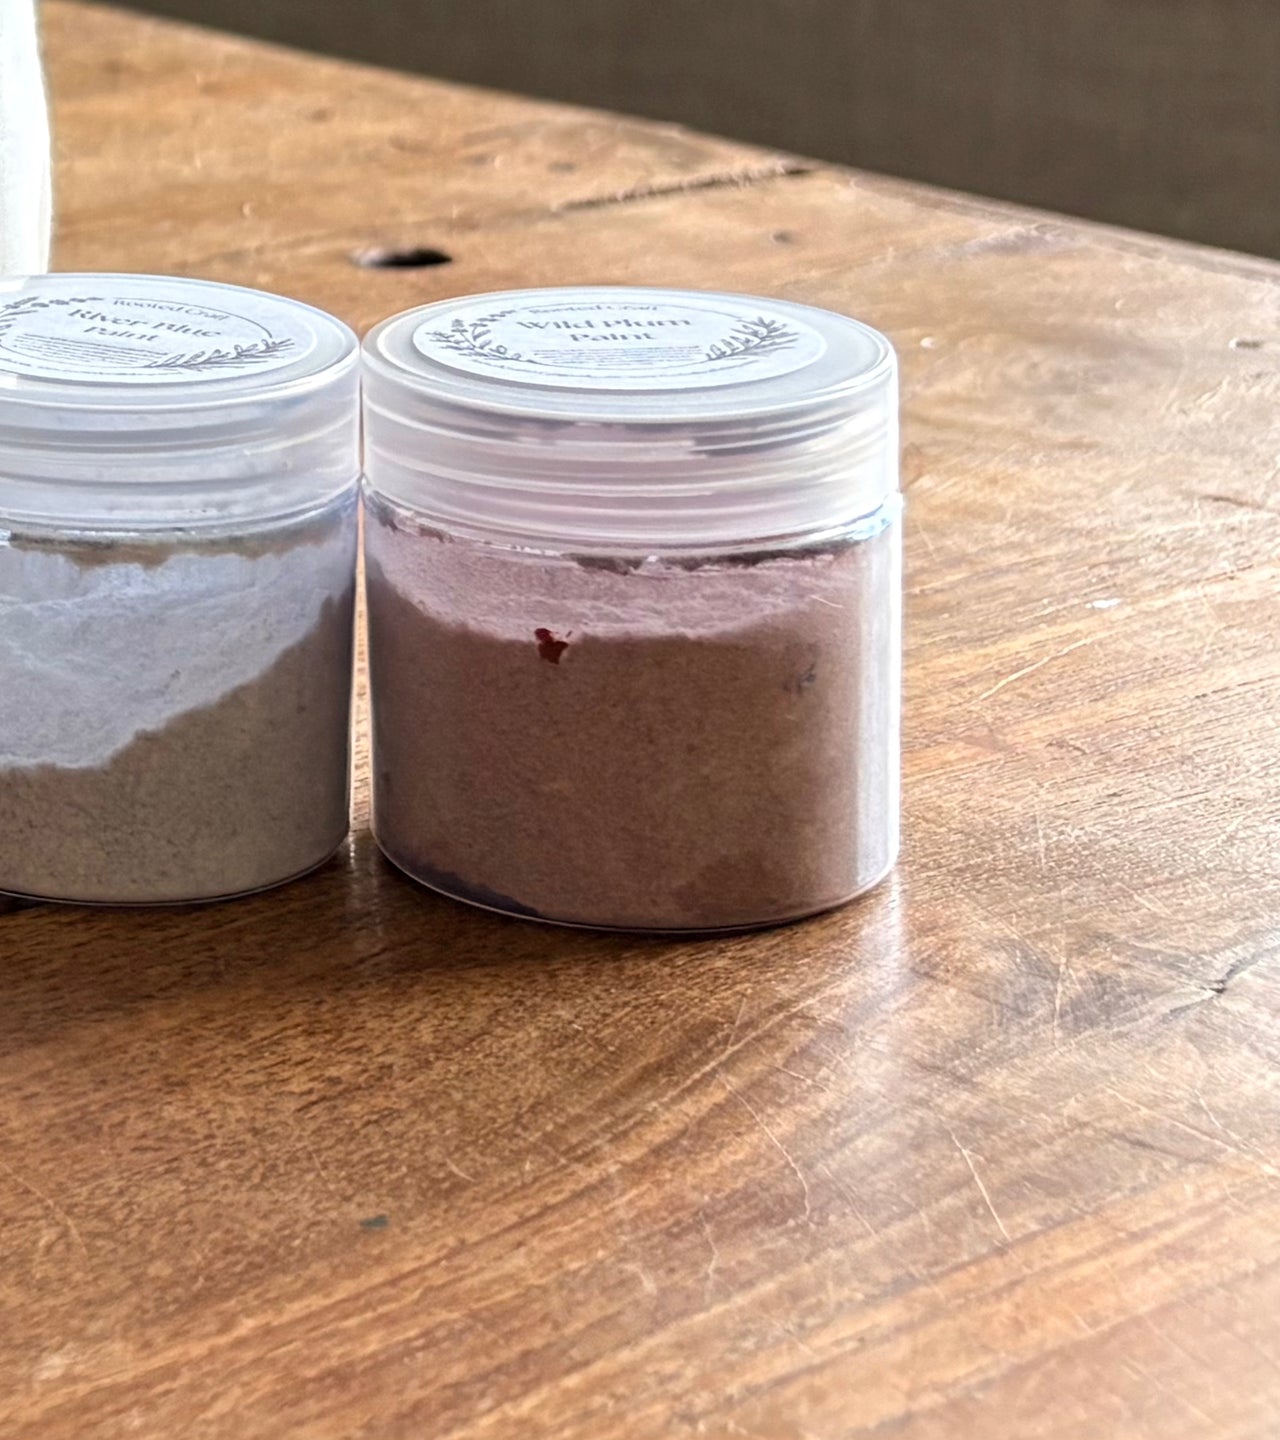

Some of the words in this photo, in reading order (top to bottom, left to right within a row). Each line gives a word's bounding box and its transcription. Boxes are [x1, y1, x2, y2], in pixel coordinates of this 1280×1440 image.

[516, 320, 594, 329] Wild
[603, 319, 691, 328] Plum
[83, 326, 159, 341] Paint
[570, 333, 656, 342] Paint
